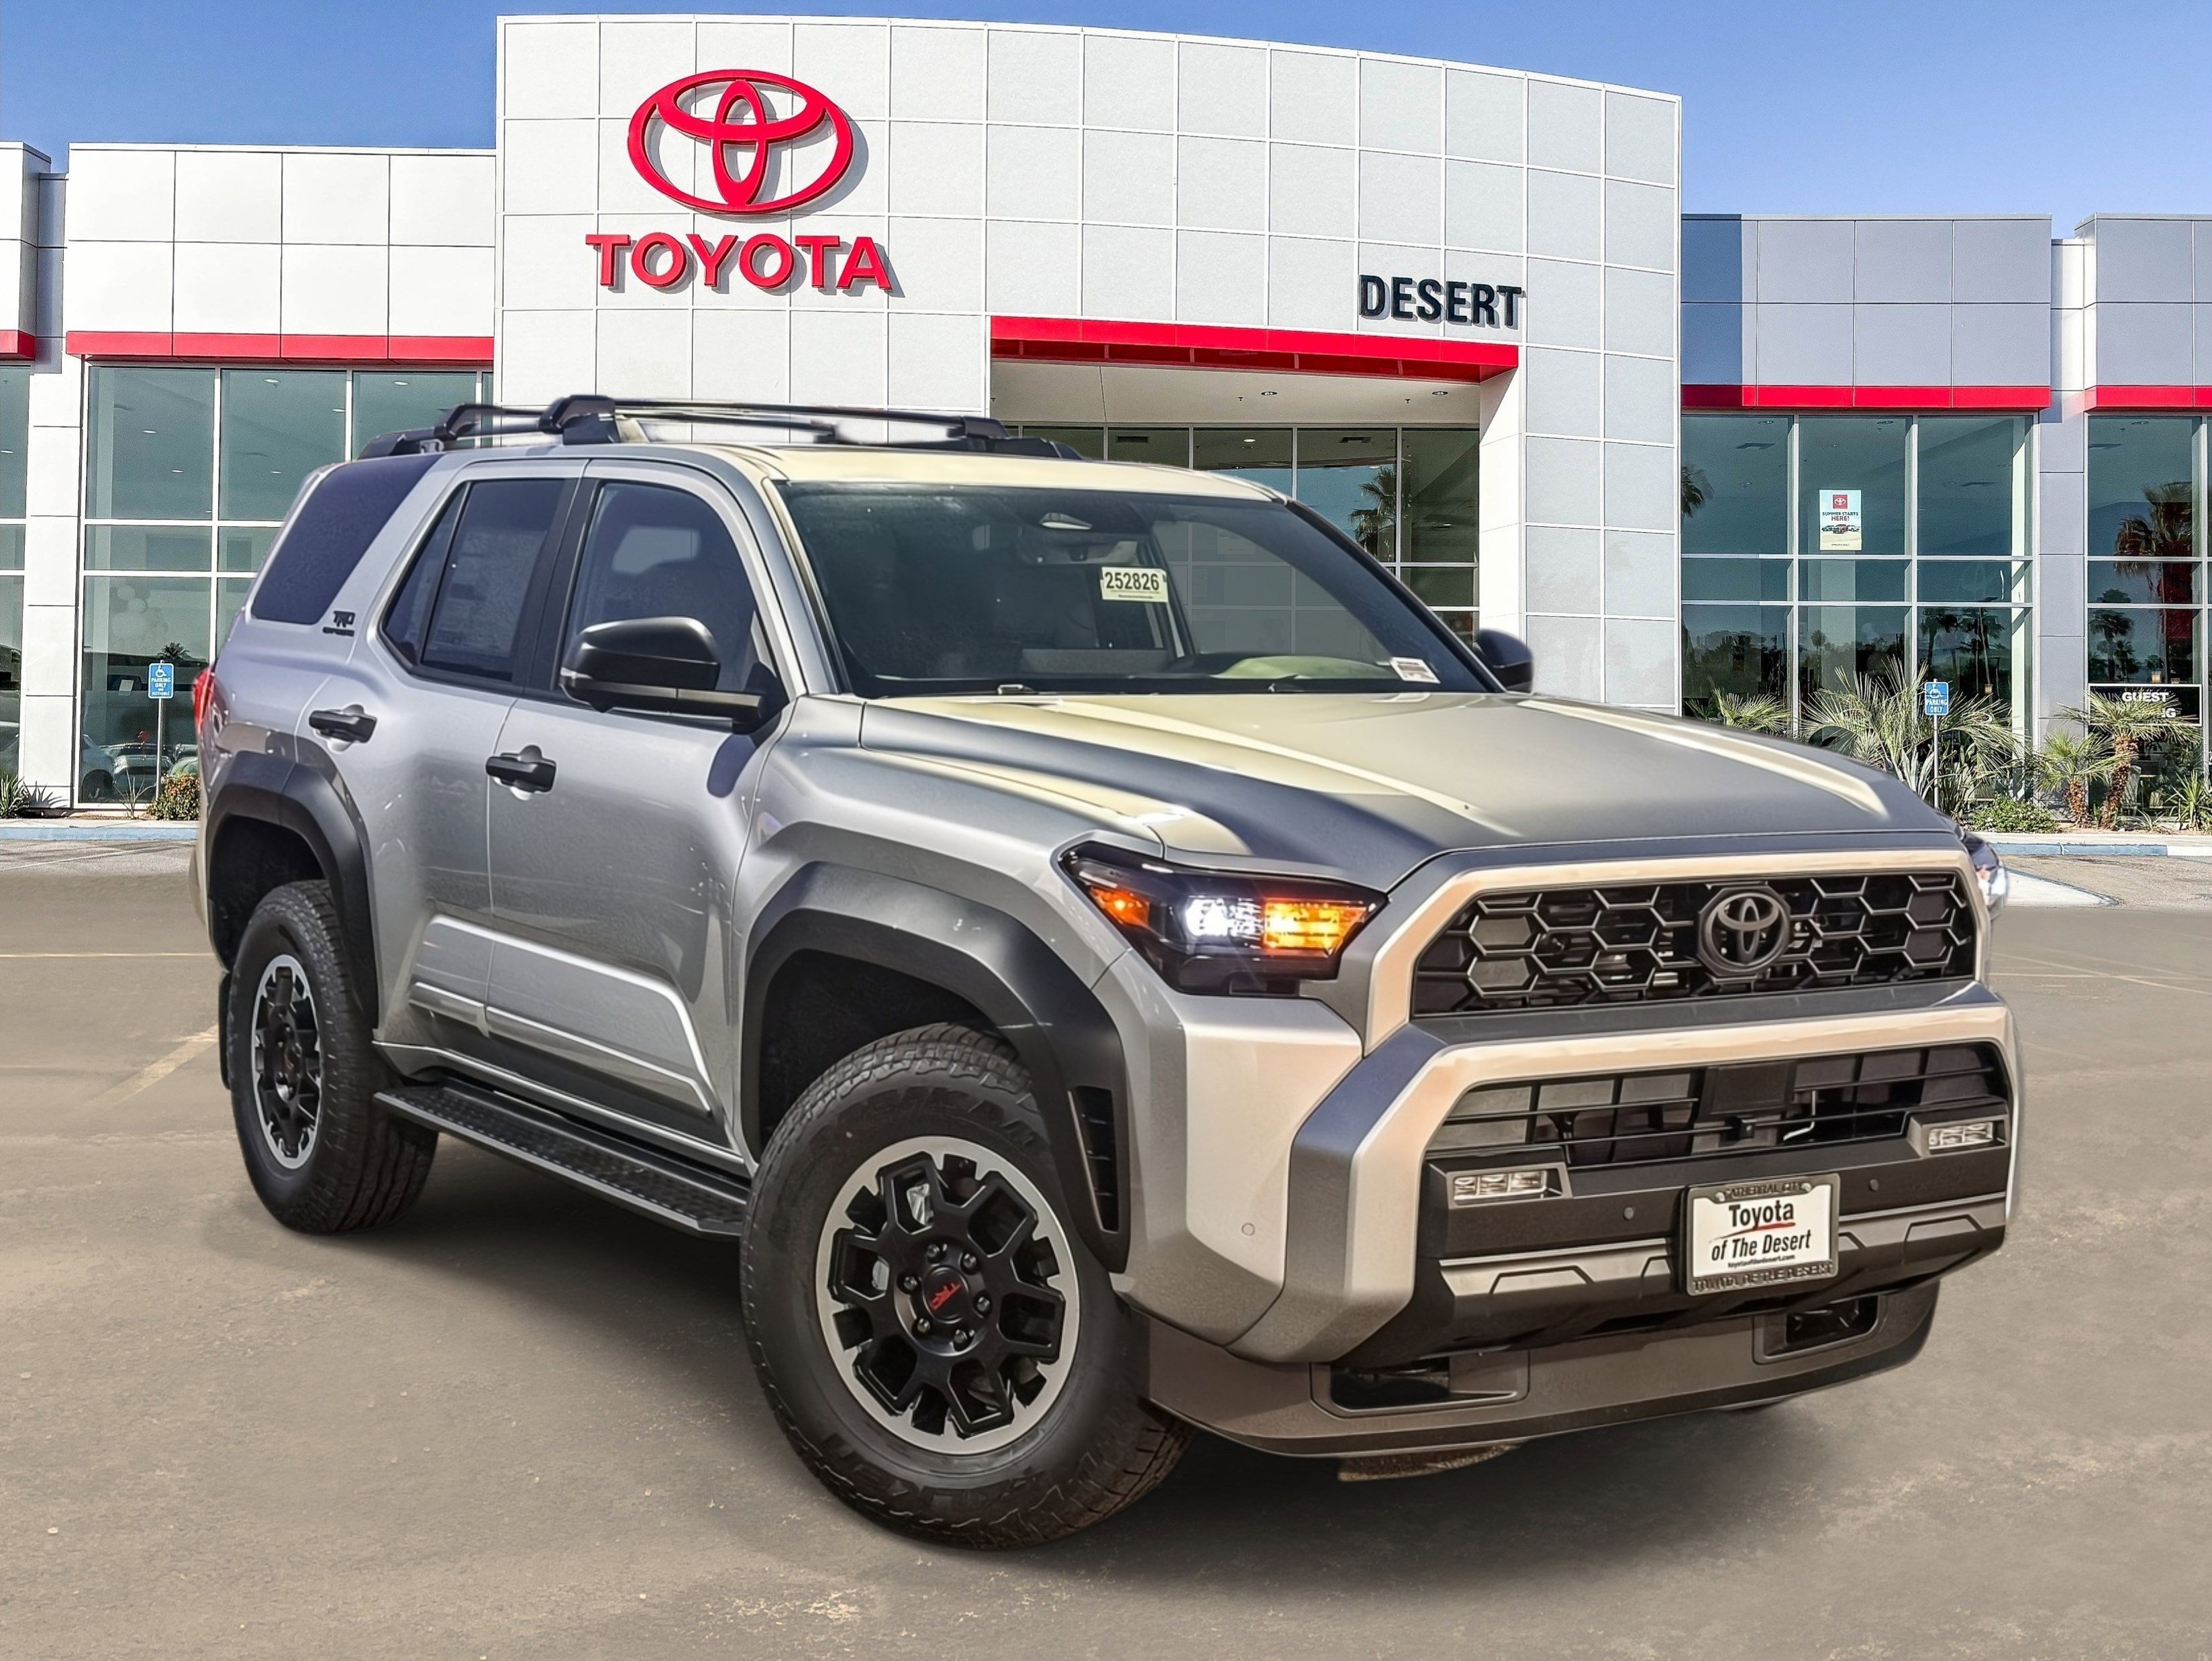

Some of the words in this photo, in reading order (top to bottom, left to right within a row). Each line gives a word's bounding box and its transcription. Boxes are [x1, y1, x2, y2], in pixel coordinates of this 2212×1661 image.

[585, 232, 891, 290] TOYOTA
[1359, 274, 1522, 326] DESERT
[1105, 572, 1160, 591] 252826
[2121, 691, 2169, 702] GUEST
[1729, 1200, 1794, 1229] Toyota
[1712, 1239, 1727, 1260] of
[1732, 1238, 1756, 1258] The
[1763, 1229, 1811, 1254] Desert
